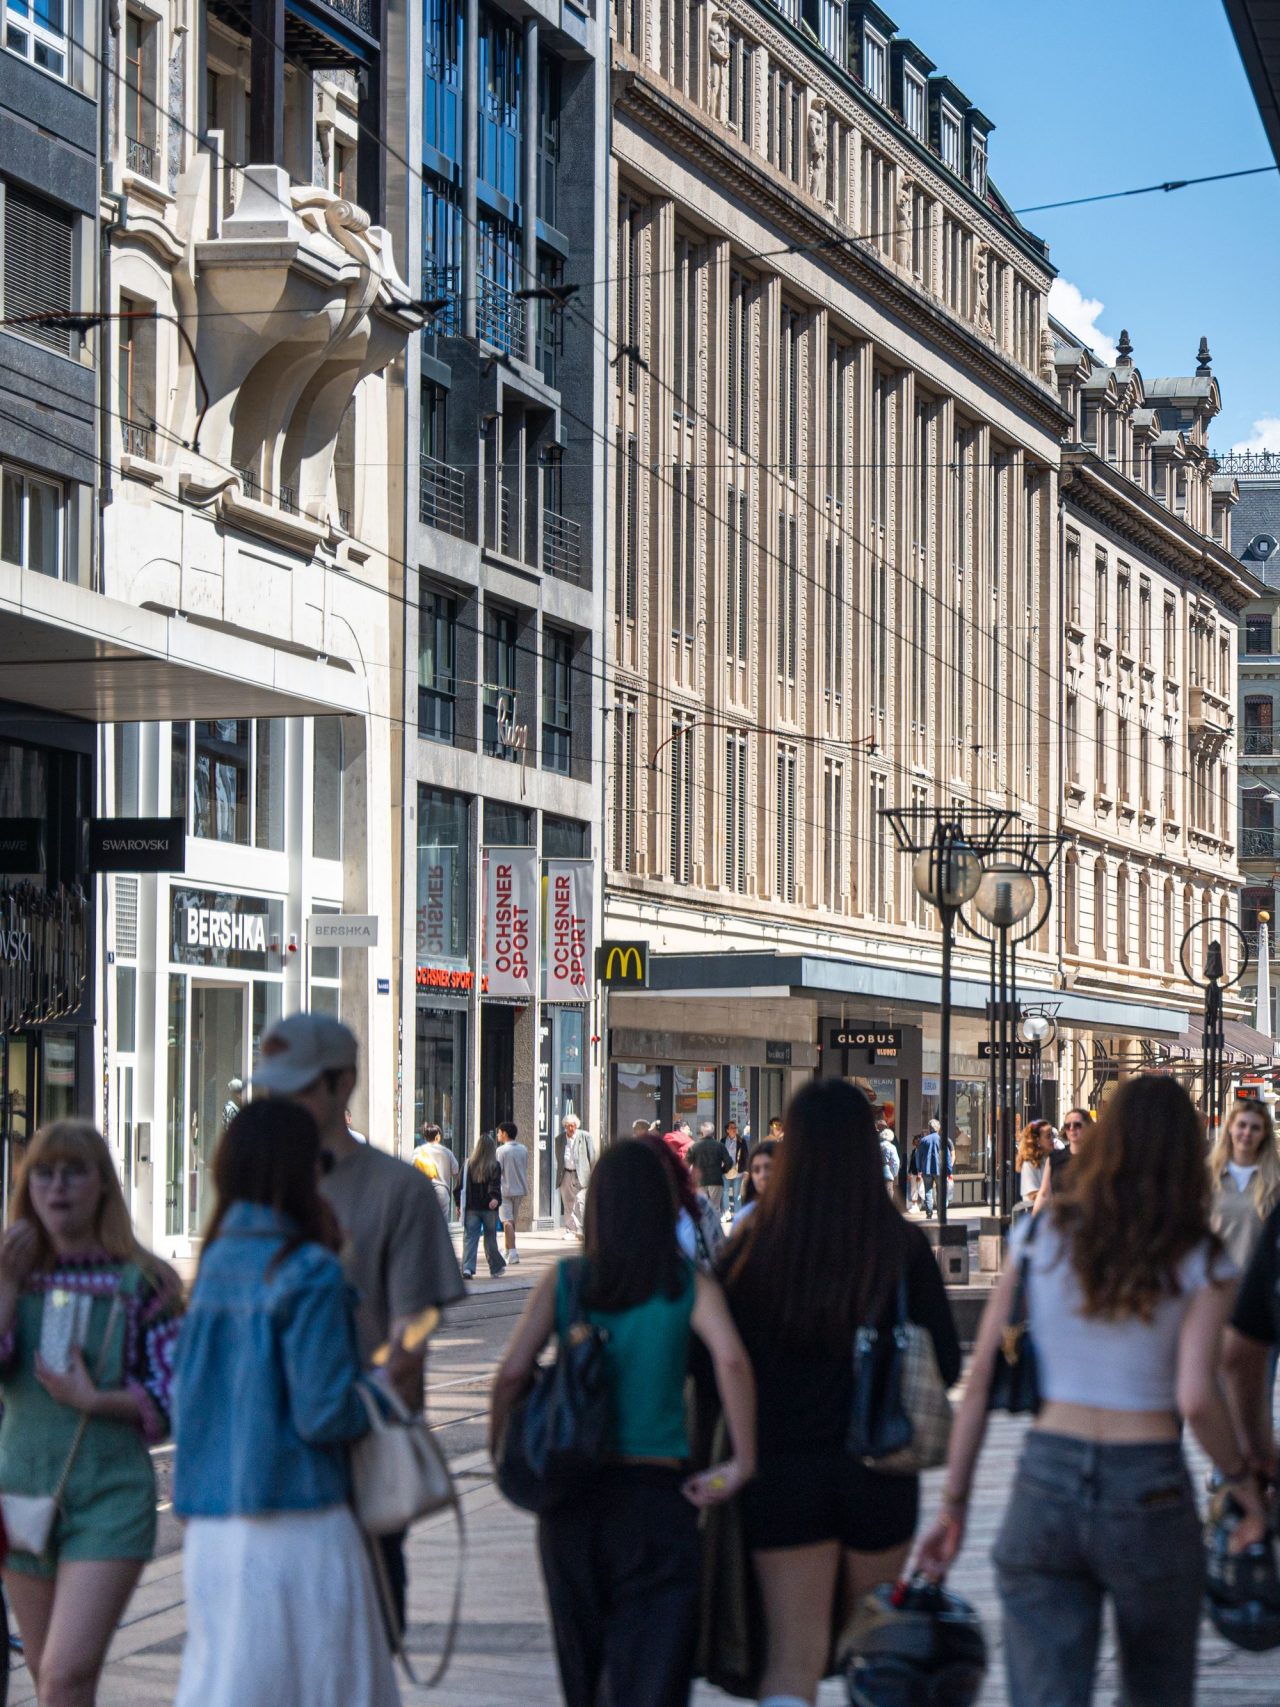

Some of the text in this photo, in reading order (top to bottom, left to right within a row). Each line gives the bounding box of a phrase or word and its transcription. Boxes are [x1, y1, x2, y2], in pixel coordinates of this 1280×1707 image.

[102, 839, 169, 851] SWAROVSKI
[187, 908, 266, 952] BERSHKA
[315, 926, 371, 936] BERSHKA
[496, 864, 512, 973] OCHSNER
[554, 876, 570, 980] OCHSNER
[0, 930, 31, 961] VSKI
[513, 904, 529, 979] SPORT
[570, 915, 586, 986] SPORT
[451, 970, 475, 989] SPORT
[837, 1034, 895, 1044] GLOBUS
